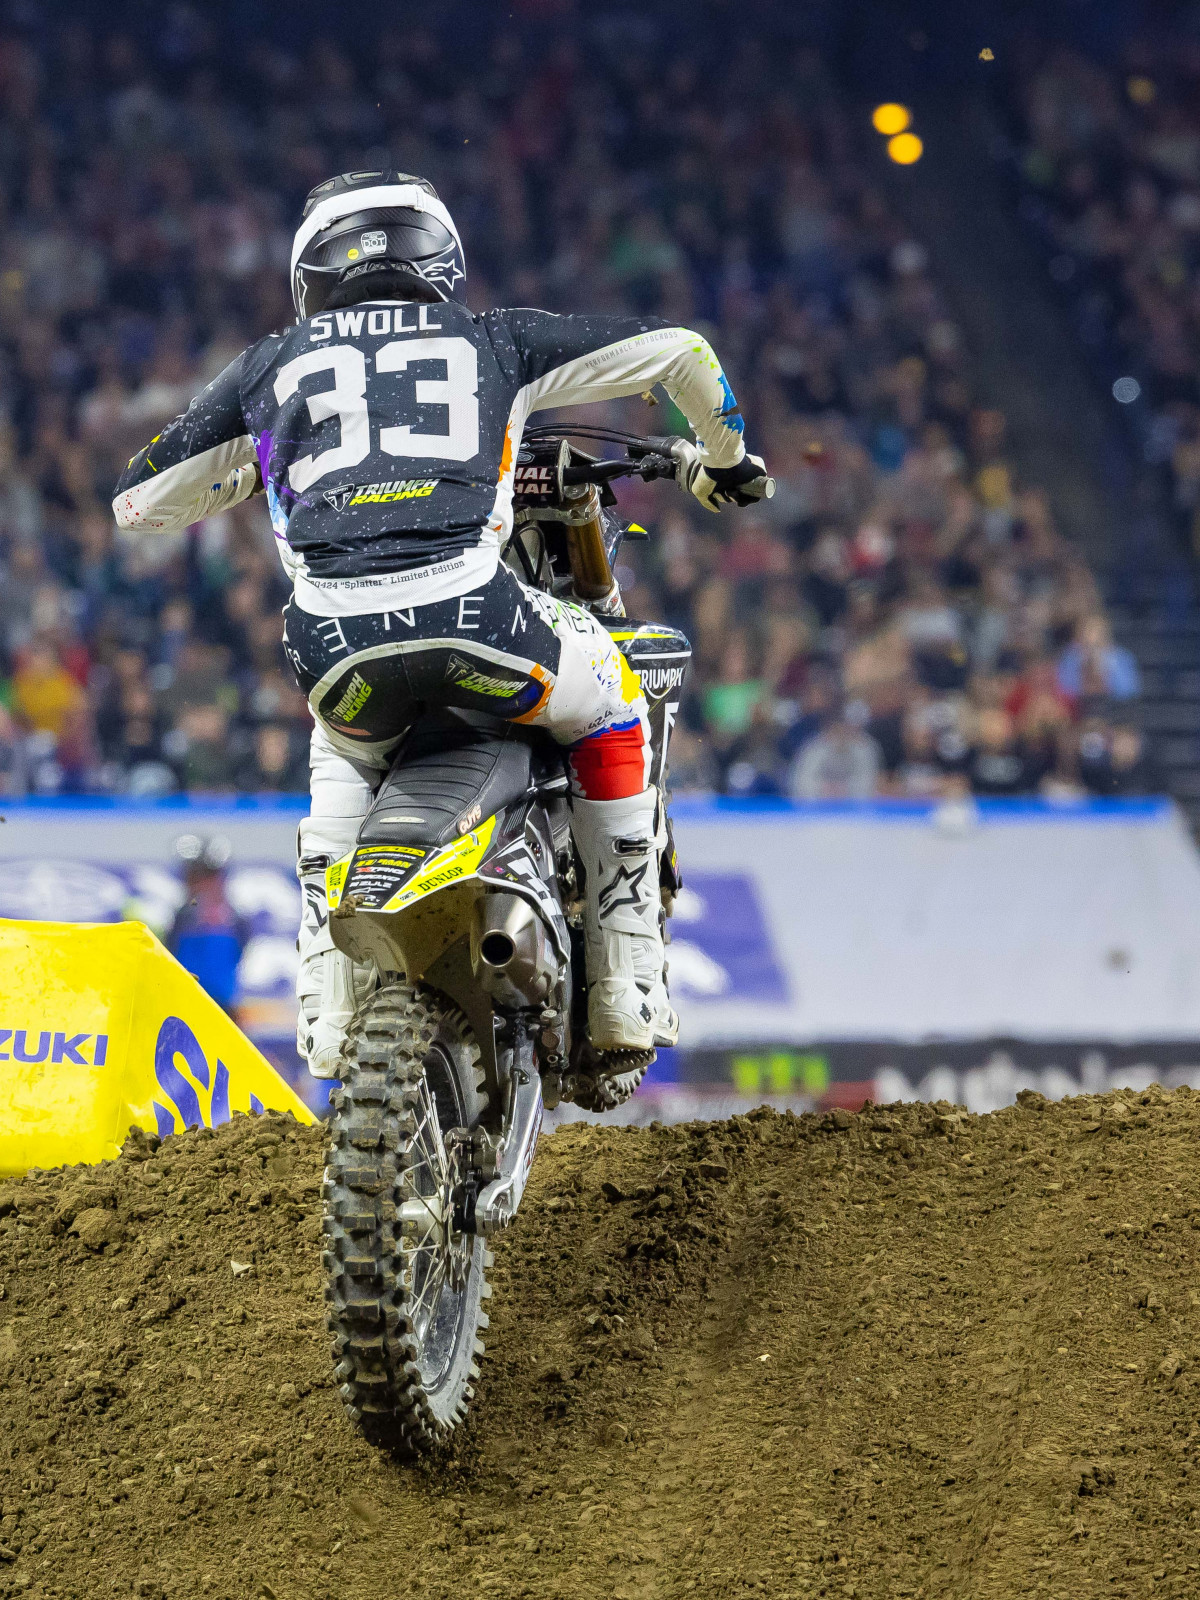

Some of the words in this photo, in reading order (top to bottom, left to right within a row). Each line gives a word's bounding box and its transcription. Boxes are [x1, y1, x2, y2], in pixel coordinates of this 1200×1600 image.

[310, 306, 442, 342] SWOLL
[585, 343, 633, 368] PERFORMANCE
[634, 331, 678, 348] MOTOCROSS
[274, 336, 479, 491] 33
[349, 486, 436, 506] RACING
[355, 479, 440, 497] TRIUMPH
[390, 569, 429, 585] Limited
[431, 559, 465, 576] Edition
[332, 671, 365, 717] TRIUMPH
[455, 680, 518, 698] RACING
[466, 671, 529, 691] TRIUMPH
[343, 681, 373, 722] RACING
[459, 804, 482, 834] GUTS
[418, 866, 464, 892] DUNLOP
